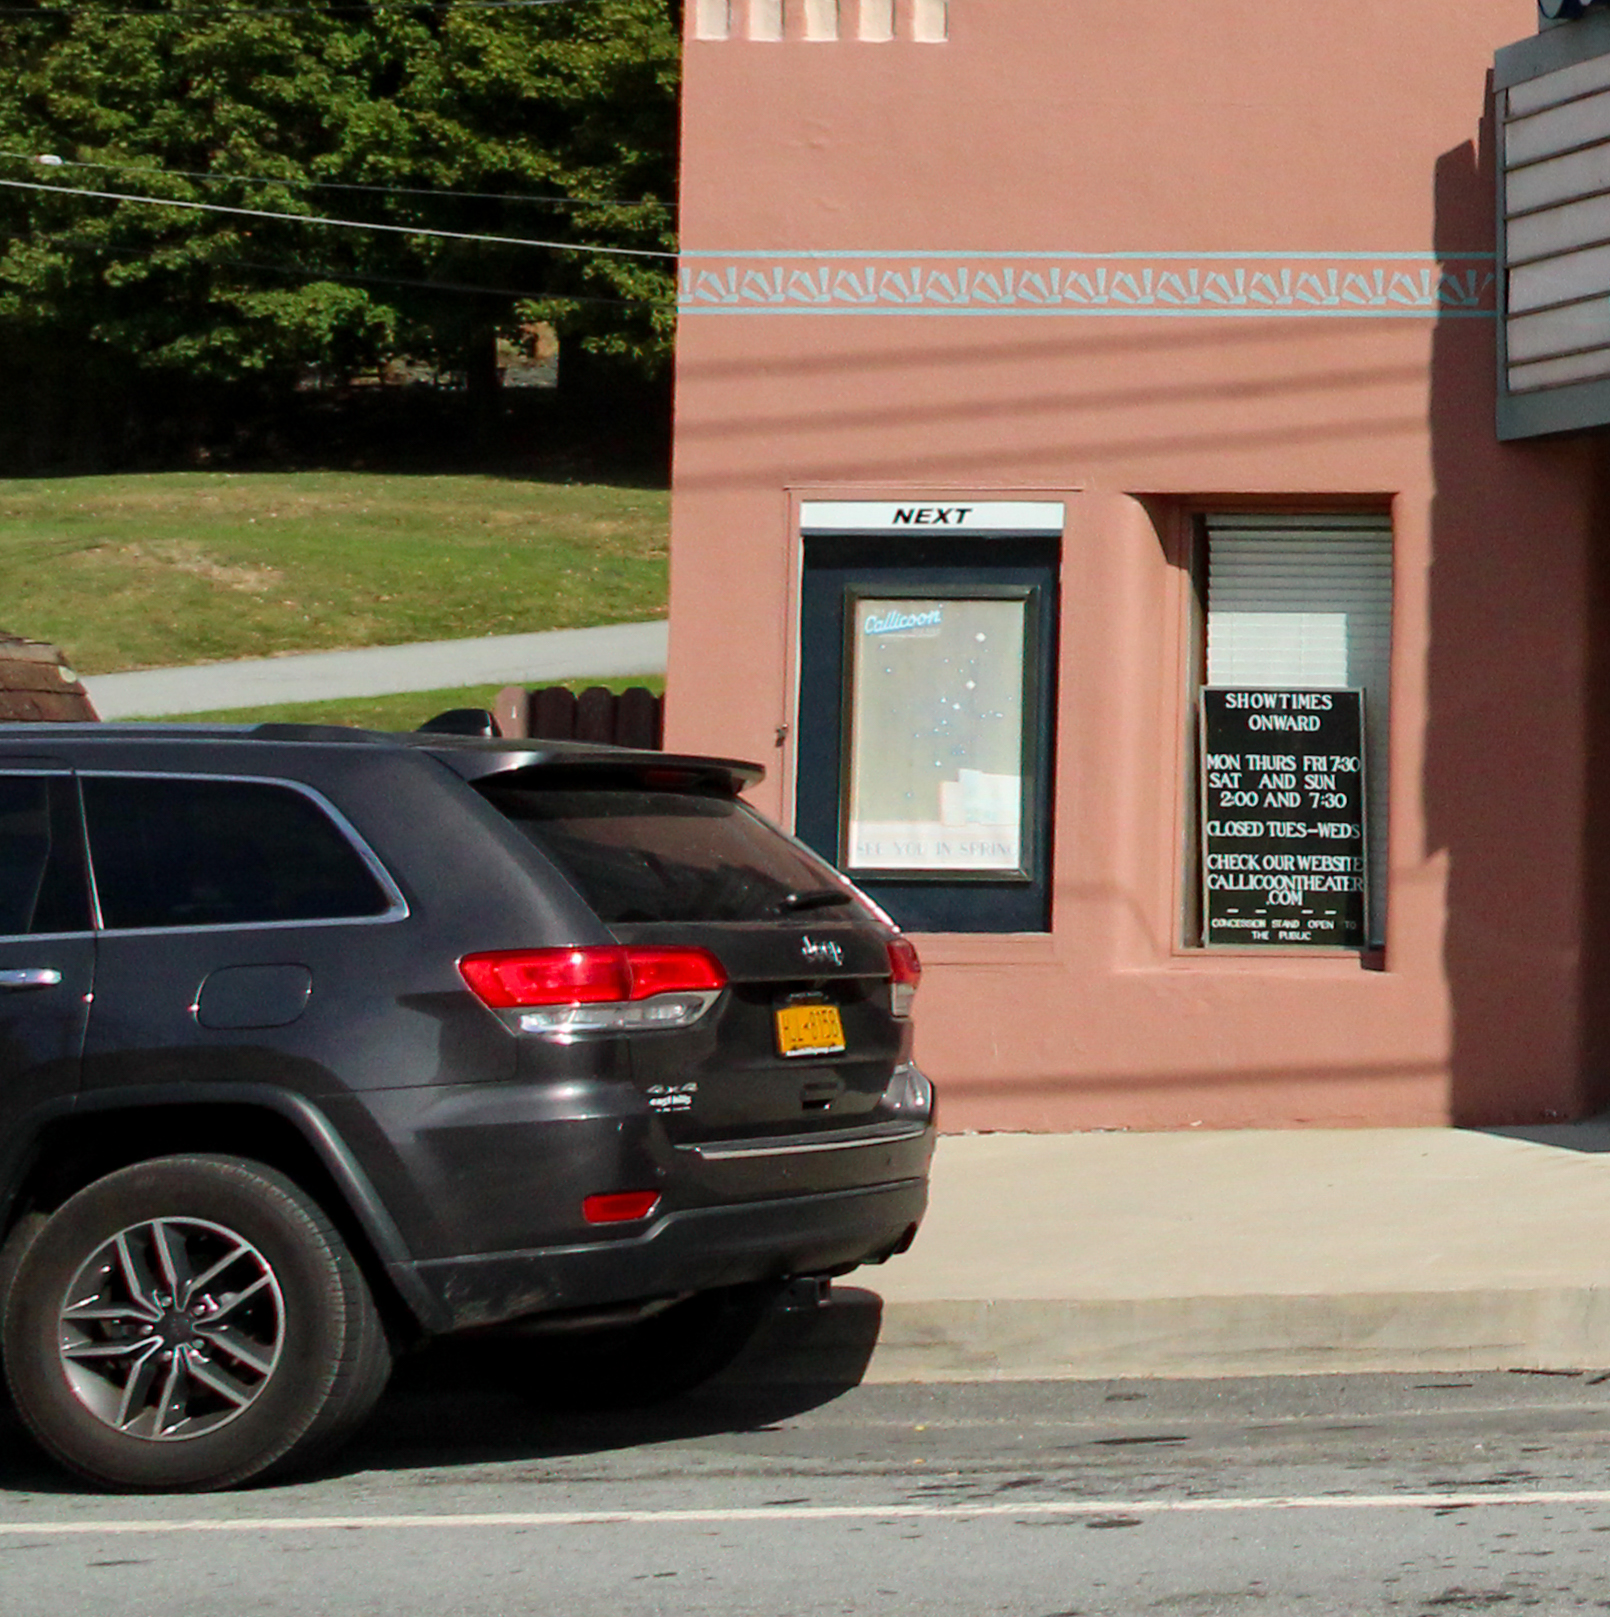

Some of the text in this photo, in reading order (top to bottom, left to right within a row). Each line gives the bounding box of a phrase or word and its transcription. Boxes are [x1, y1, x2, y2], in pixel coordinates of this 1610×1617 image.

[892, 508, 973, 525] NEXT
[864, 609, 943, 635] Callicoon
[1225, 692, 1333, 710] SHOWTIMES
[1248, 714, 1321, 731] ONWARD
[1206, 753, 1361, 773] MON THURS FRI 7:30
[1209, 772, 1336, 790] SAT AND SUN
[1219, 790, 1347, 809] 2:00 AND 7:30
[1206, 820, 1264, 837] CLOSED
[1206, 854, 1363, 872] CHECK OUR WEBSITE
[1206, 873, 1364, 892] CALLICOONTHEATER
[1265, 889, 1303, 906] .COM
[1271, 919, 1300, 929] STAND
[1307, 919, 1335, 929] OPEN
[1251, 930, 1312, 940] THE PUBLIC
